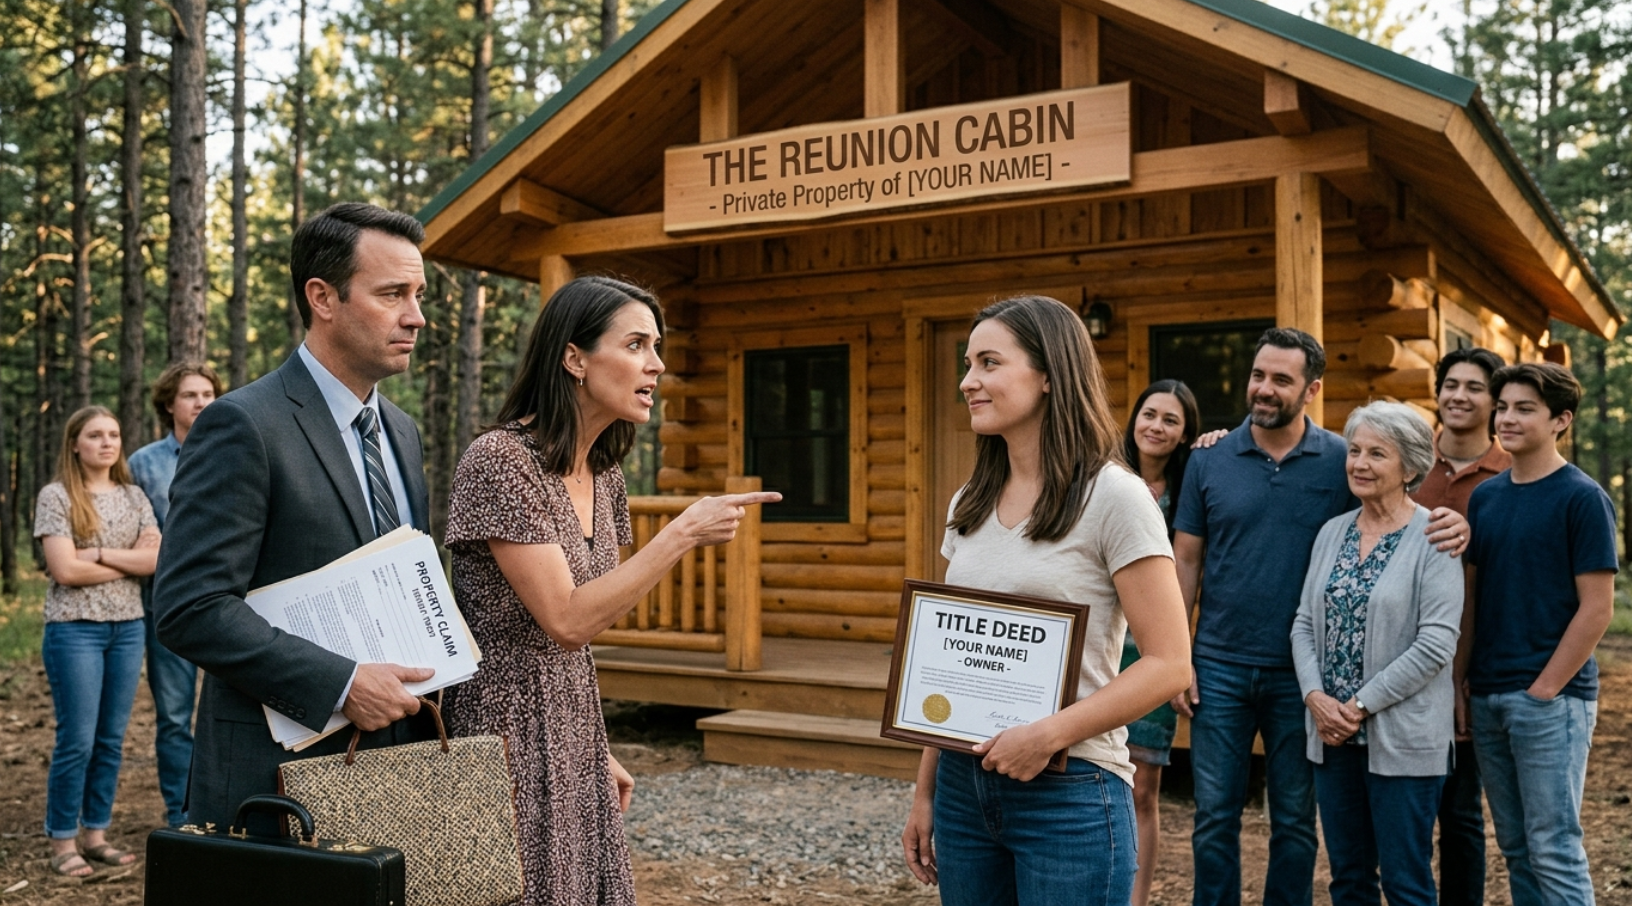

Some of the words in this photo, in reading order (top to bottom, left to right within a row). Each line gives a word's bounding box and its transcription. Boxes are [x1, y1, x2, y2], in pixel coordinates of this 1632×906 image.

[703, 145, 767, 186] THE
[780, 120, 940, 178] REUNION
[955, 101, 1075, 154] CABIN
[723, 188, 787, 215] Private
[793, 177, 875, 208] Property
[881, 171, 902, 196] of
[908, 163, 972, 197] [YOUR
[980, 152, 1052, 181] NAME]
[415, 560, 444, 618] PROPERTY
[437, 620, 458, 657] CLAIM
[935, 611, 988, 636] TITLE
[992, 620, 1047, 644] DEED
[943, 637, 983, 654] [YOUR
[985, 644, 1028, 663] NAME]
[964, 656, 1005, 673] OWNER
